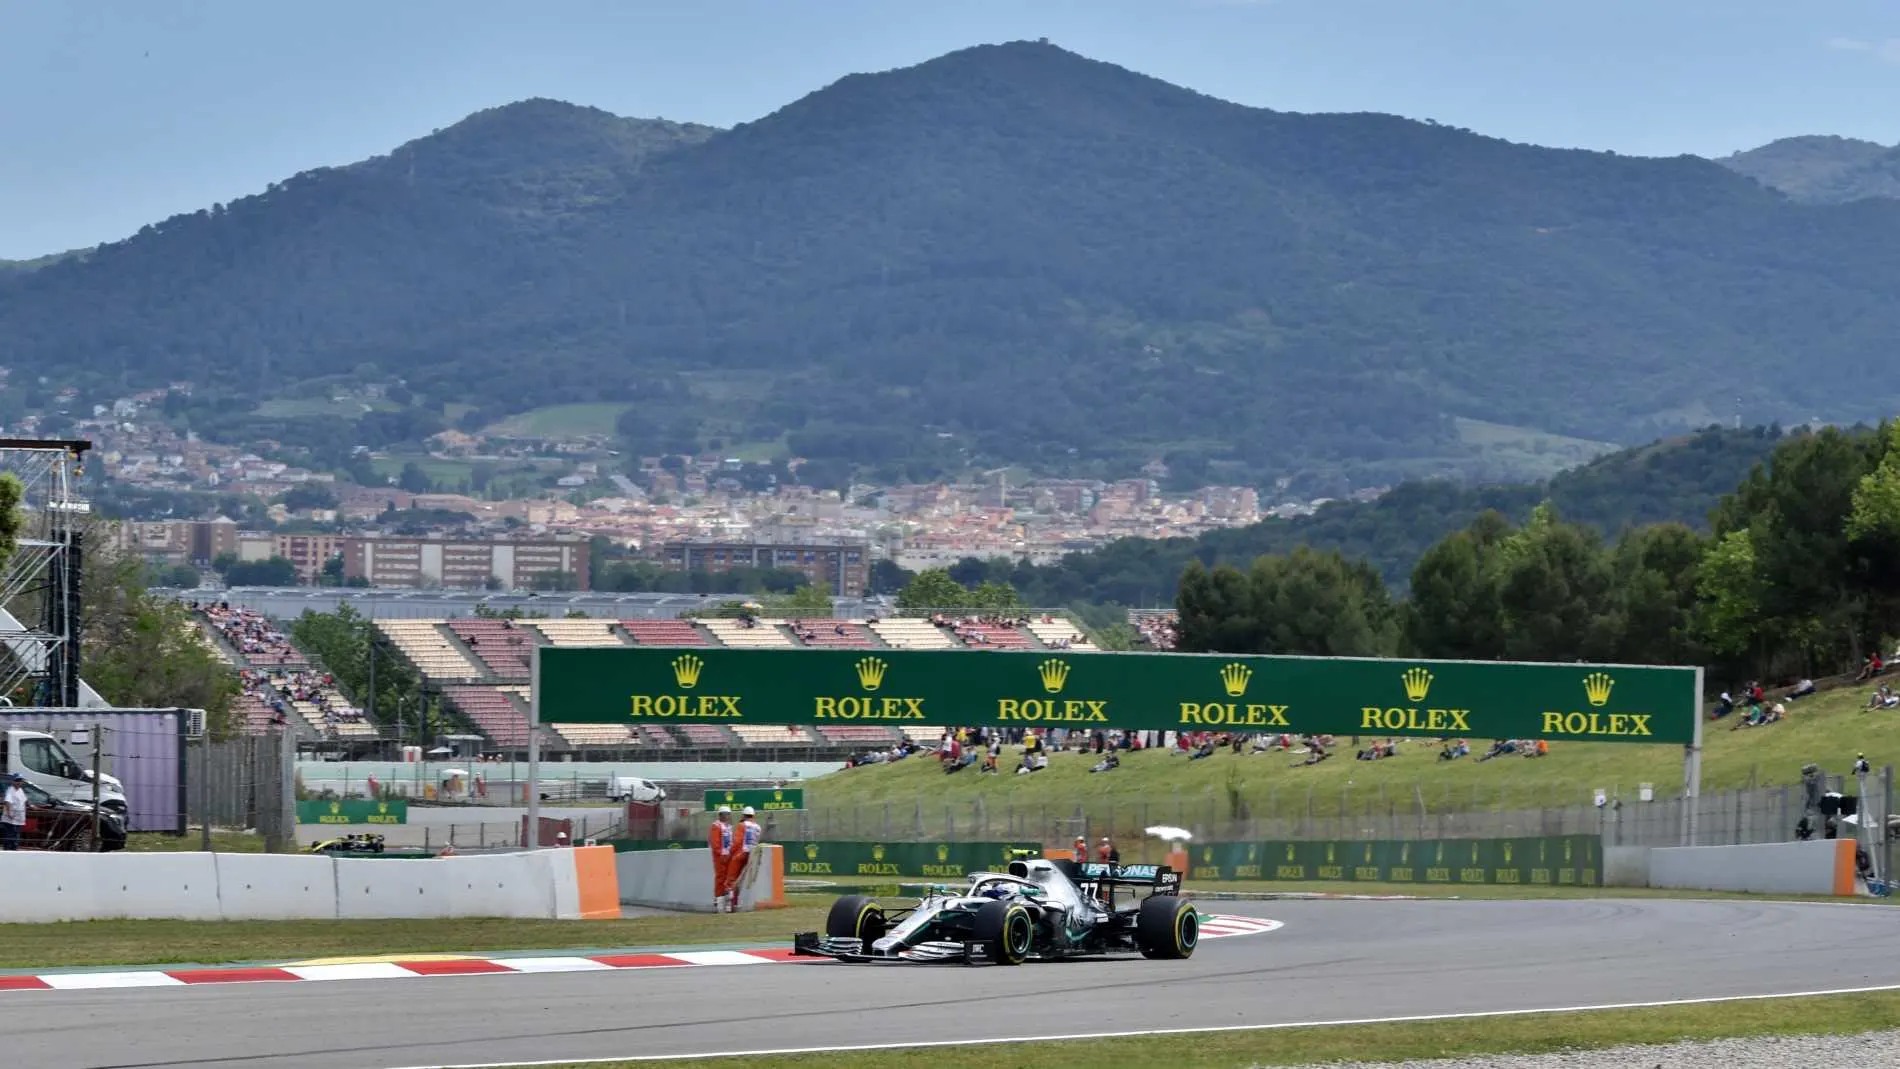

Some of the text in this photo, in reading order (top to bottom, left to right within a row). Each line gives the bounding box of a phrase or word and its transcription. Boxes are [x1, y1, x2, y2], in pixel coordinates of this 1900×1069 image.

[630, 695, 741, 717] ROLEX
[814, 697, 925, 719] ROLEX
[997, 699, 1108, 722] ROLEX
[1179, 702, 1289, 726] ROLEX
[1361, 706, 1472, 731] ROLEX
[1542, 711, 1652, 736] ROLEX
[790, 862, 832, 874] ROLEX
[858, 863, 899, 875] ROLEX
[922, 864, 963, 876] ROLEX
[1087, 863, 1158, 877] PETONAS
[1081, 883, 1100, 904] 77
